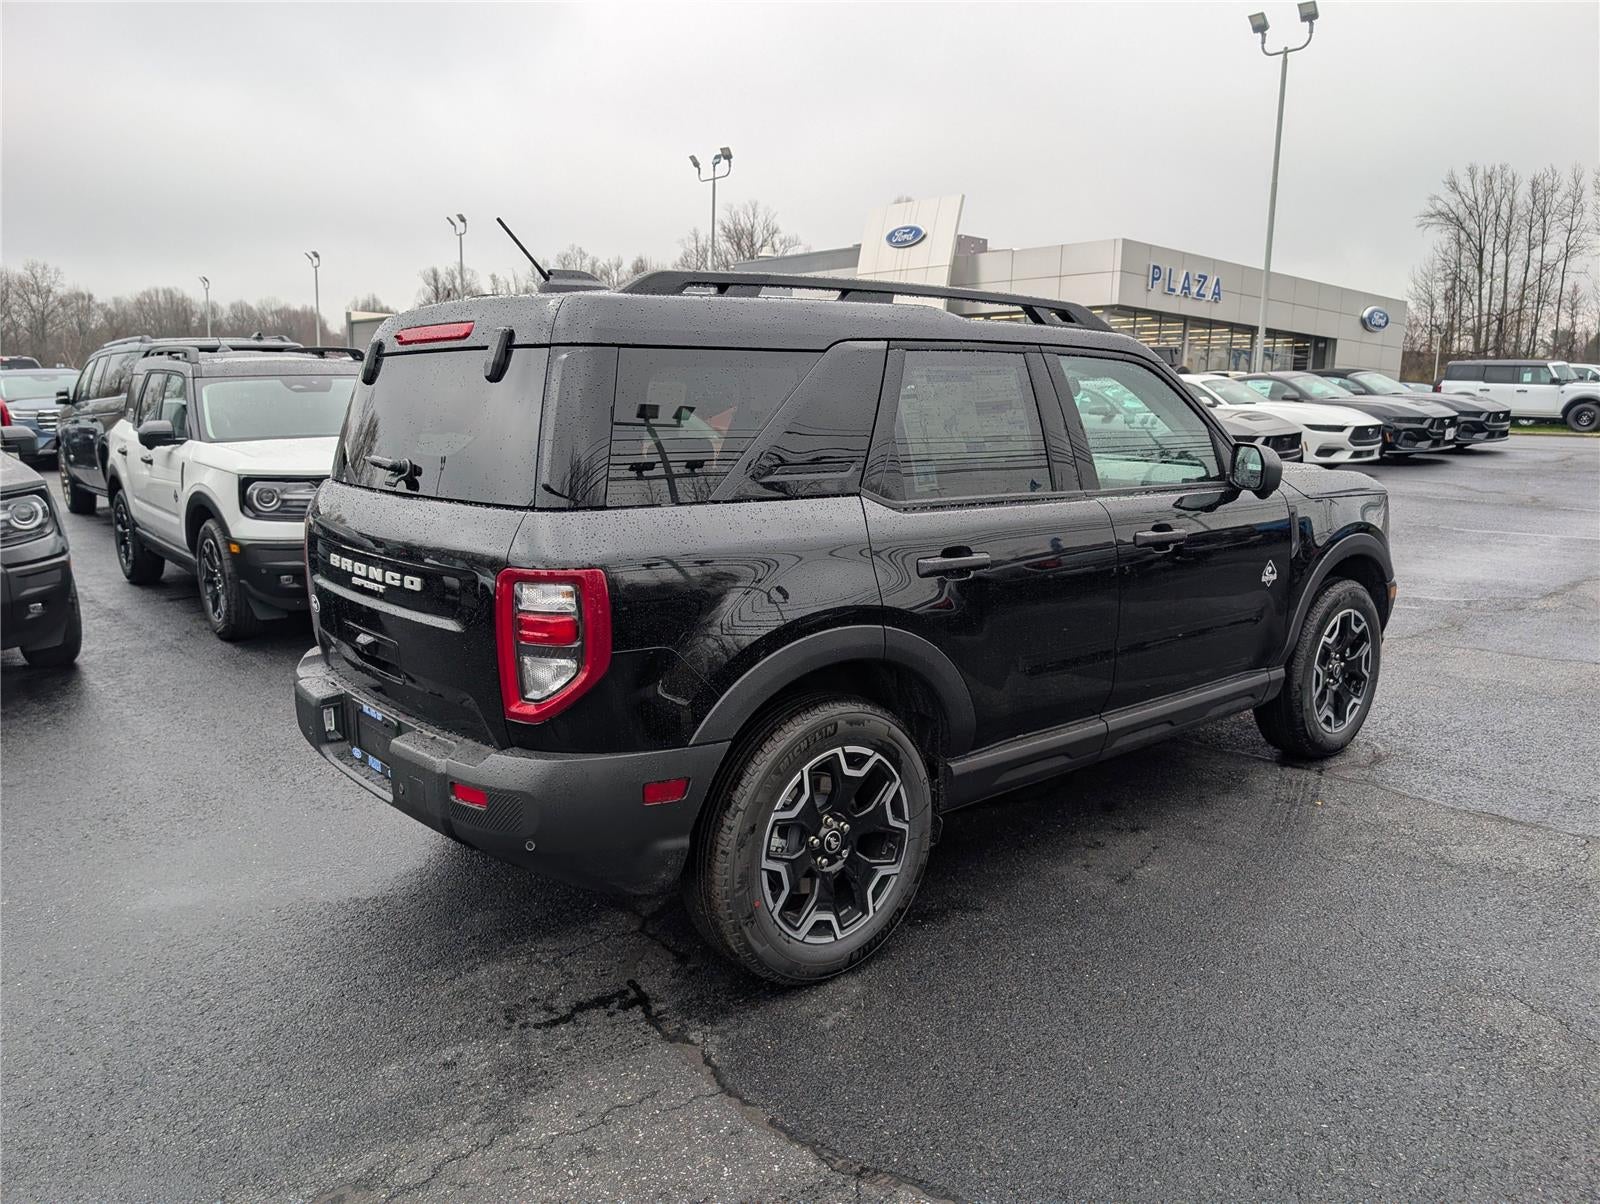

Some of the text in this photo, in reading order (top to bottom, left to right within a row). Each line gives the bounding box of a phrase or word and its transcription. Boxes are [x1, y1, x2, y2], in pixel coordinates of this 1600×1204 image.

[1149, 263, 1222, 302] PLAZA
[330, 553, 421, 591] BRONCO
[351, 576, 386, 593] SPORT
[779, 721, 839, 774] MICHELIN
